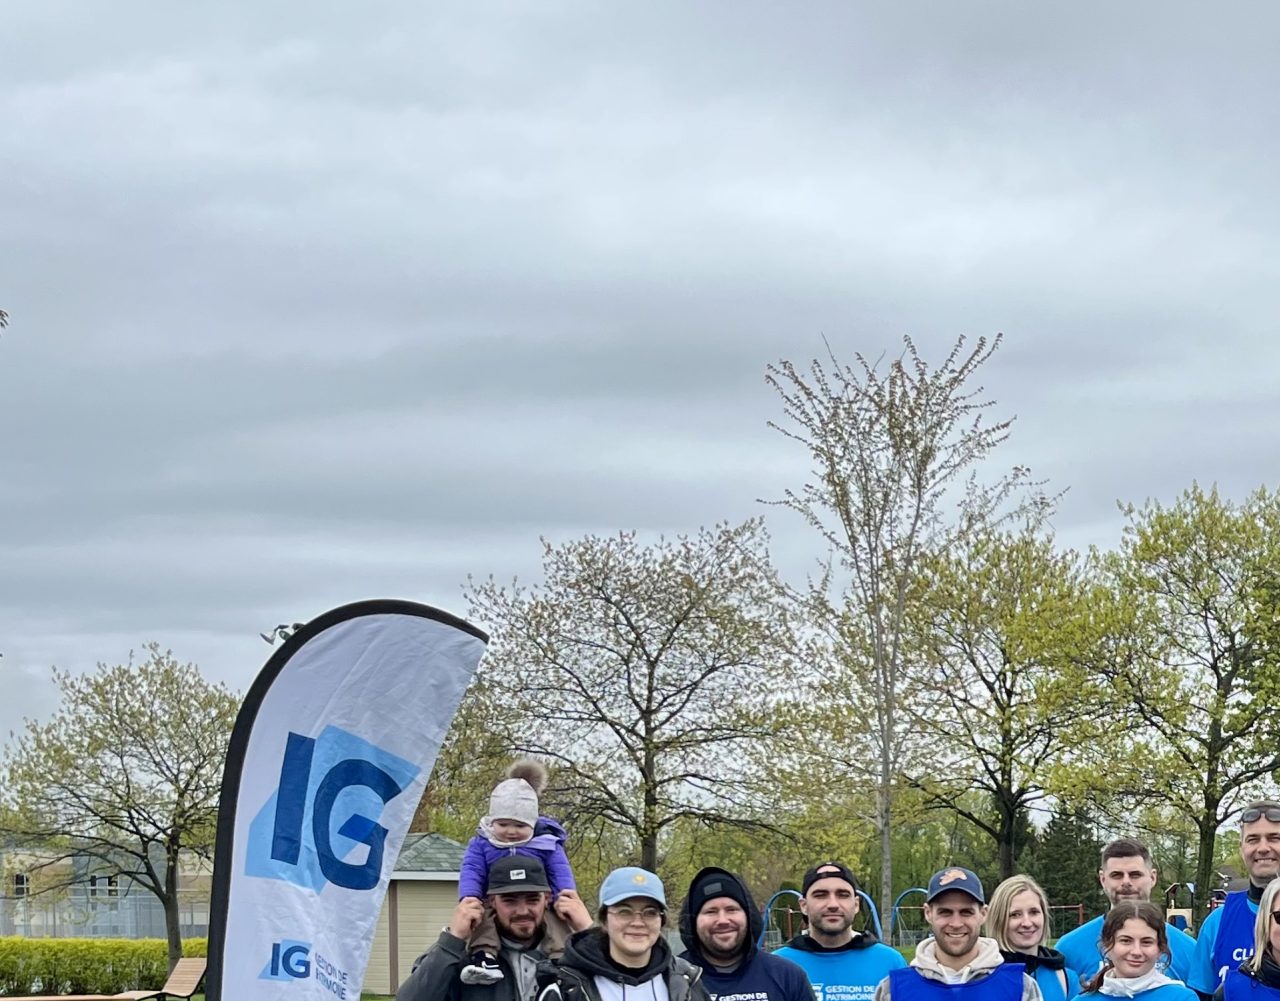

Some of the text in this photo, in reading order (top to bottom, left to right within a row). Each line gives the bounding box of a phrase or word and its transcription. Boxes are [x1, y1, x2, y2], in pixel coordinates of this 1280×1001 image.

[270, 731, 402, 891] IG
[270, 943, 311, 979] IG
[825, 985, 875, 993] GESTION DE
